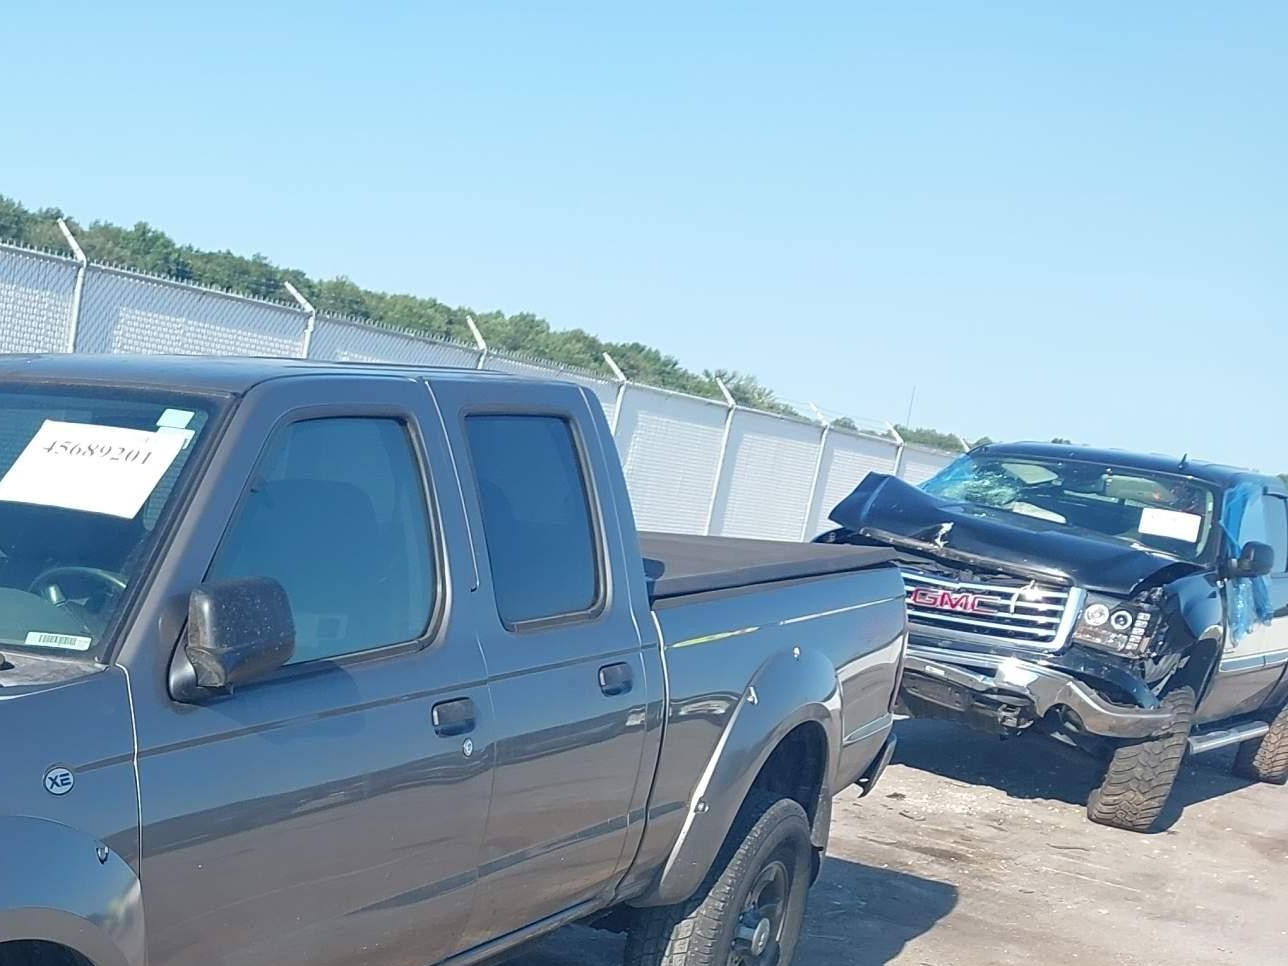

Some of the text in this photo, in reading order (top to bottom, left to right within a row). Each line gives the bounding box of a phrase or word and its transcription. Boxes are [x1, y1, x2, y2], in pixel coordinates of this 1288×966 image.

[43, 440, 152, 465] 45689201
[911, 586, 1000, 613] GMC
[47, 772, 72, 789] XE
